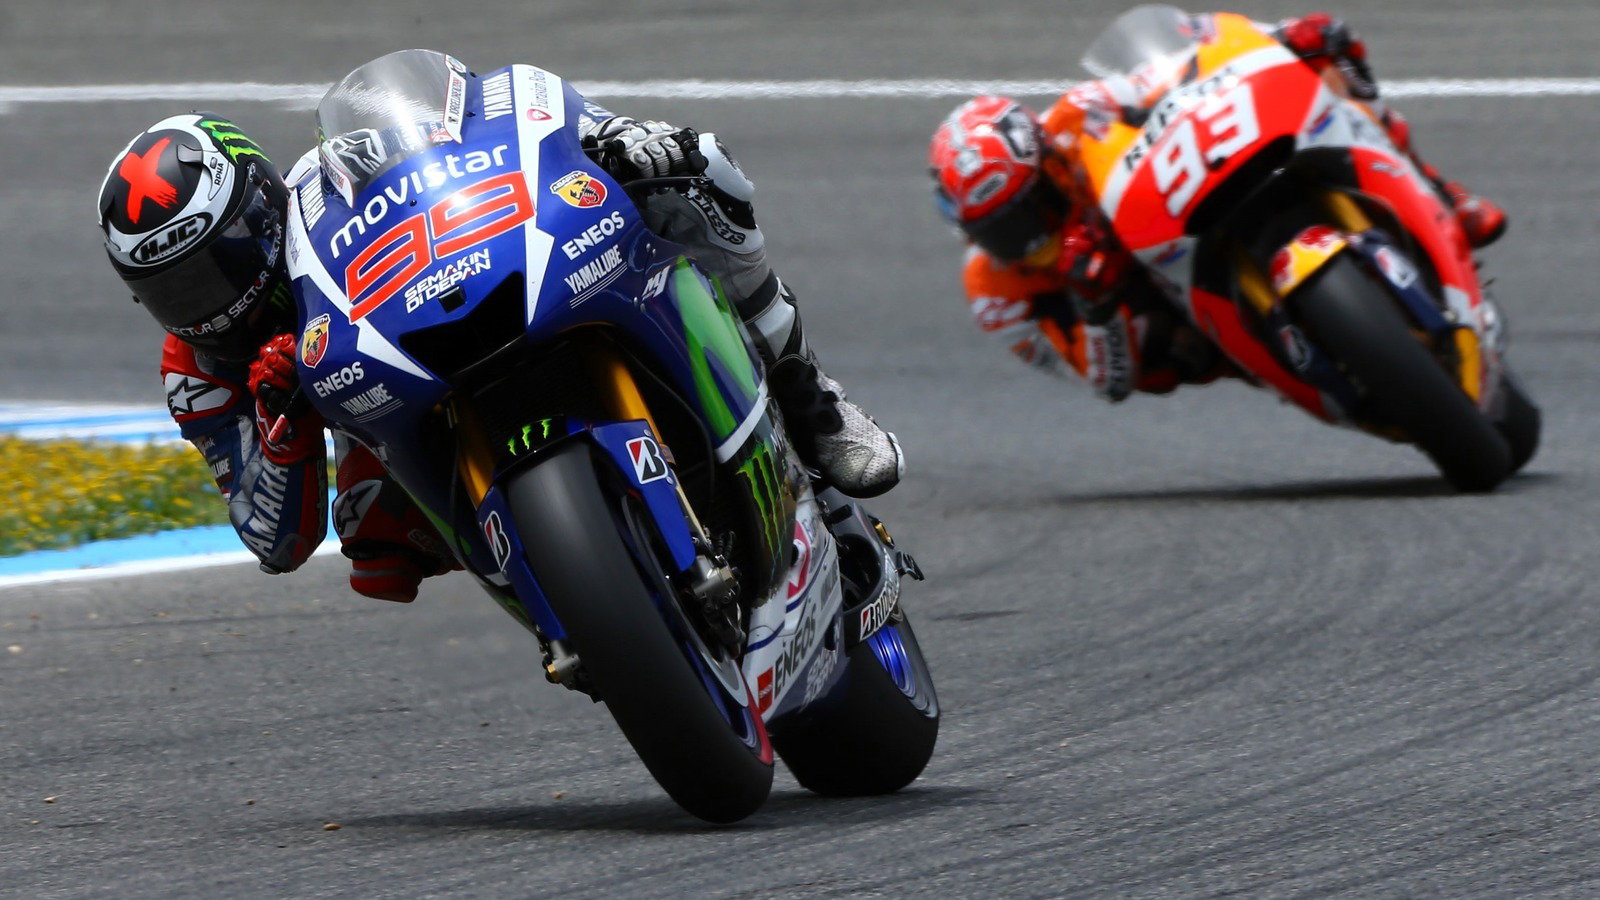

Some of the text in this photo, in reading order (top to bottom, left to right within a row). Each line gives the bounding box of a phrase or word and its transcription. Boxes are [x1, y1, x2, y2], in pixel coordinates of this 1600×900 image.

[482, 71, 514, 121] YAMAHA
[213, 162, 225, 186] RPHA
[1152, 81, 1261, 219] 93
[330, 144, 509, 259] movistar
[139, 215, 200, 263] HJC
[345, 170, 538, 325] 99
[561, 210, 625, 261] ENEOS
[228, 270, 271, 320] SECTOR
[404, 247, 490, 299] SEMAKIN
[405, 258, 491, 314] DI DEPAN
[563, 244, 623, 295] YAMALUBE
[312, 361, 365, 399] ENEOS
[340, 382, 394, 416] YAMALUBE
[241, 455, 289, 558] AMAHA
